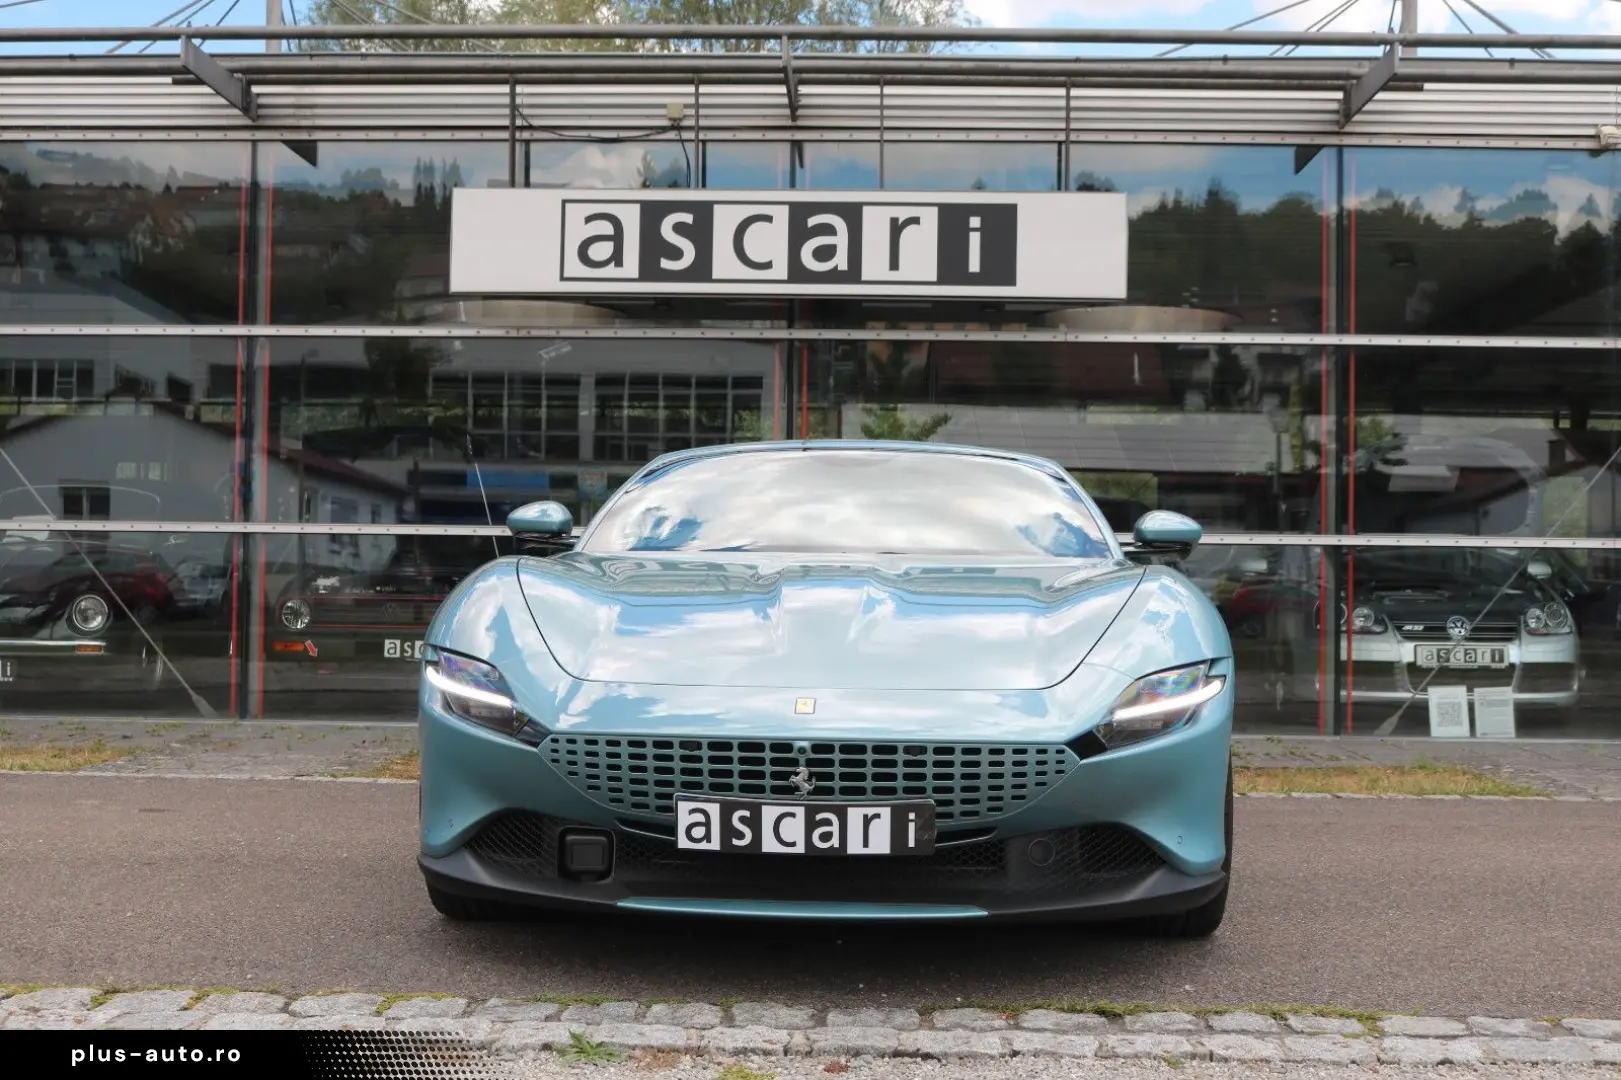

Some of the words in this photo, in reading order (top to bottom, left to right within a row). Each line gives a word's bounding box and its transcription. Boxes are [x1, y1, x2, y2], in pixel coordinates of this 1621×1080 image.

[576, 211, 983, 274] ascari
[1424, 647, 1499, 662] ascari
[685, 807, 916, 849] ascari
